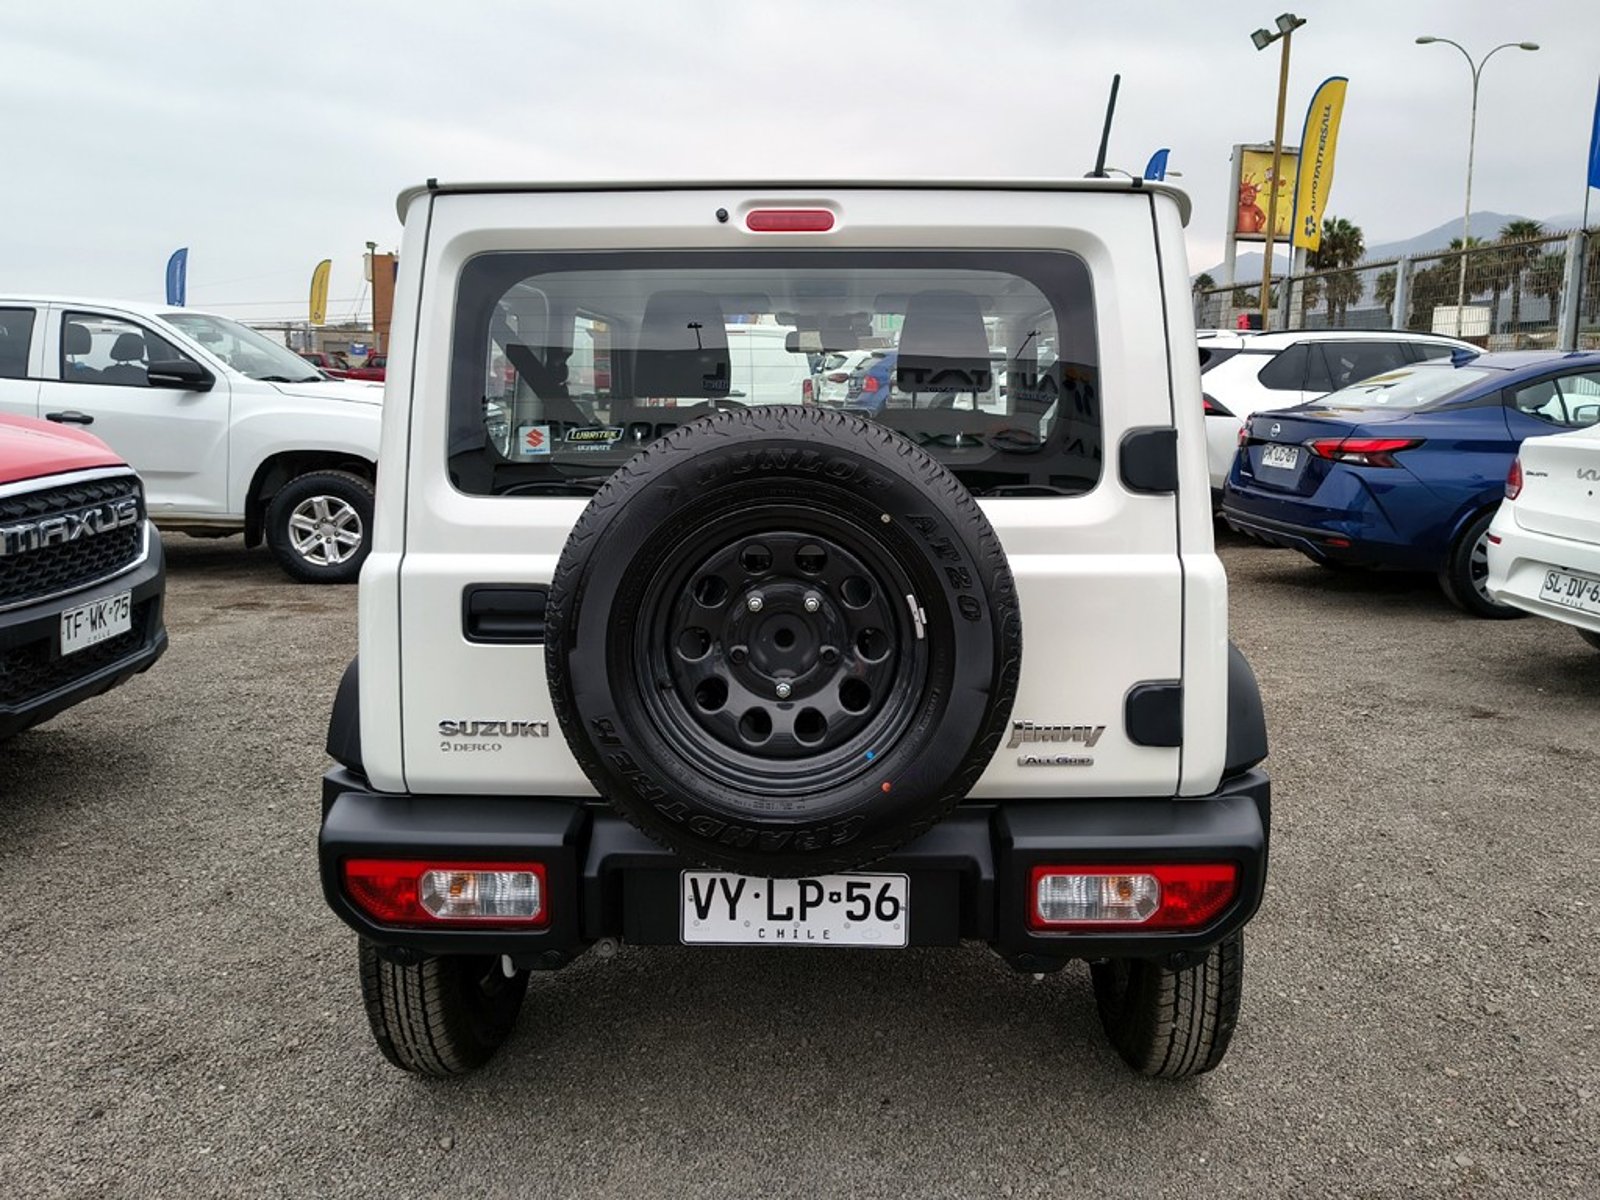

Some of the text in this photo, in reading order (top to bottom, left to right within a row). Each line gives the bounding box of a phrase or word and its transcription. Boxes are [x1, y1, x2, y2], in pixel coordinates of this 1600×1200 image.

[0, 499, 137, 556] MAXUS
[438, 720, 549, 737] SUZUKI
[453, 742, 502, 752] DERCO
[758, 928, 831, 940] CHILE
